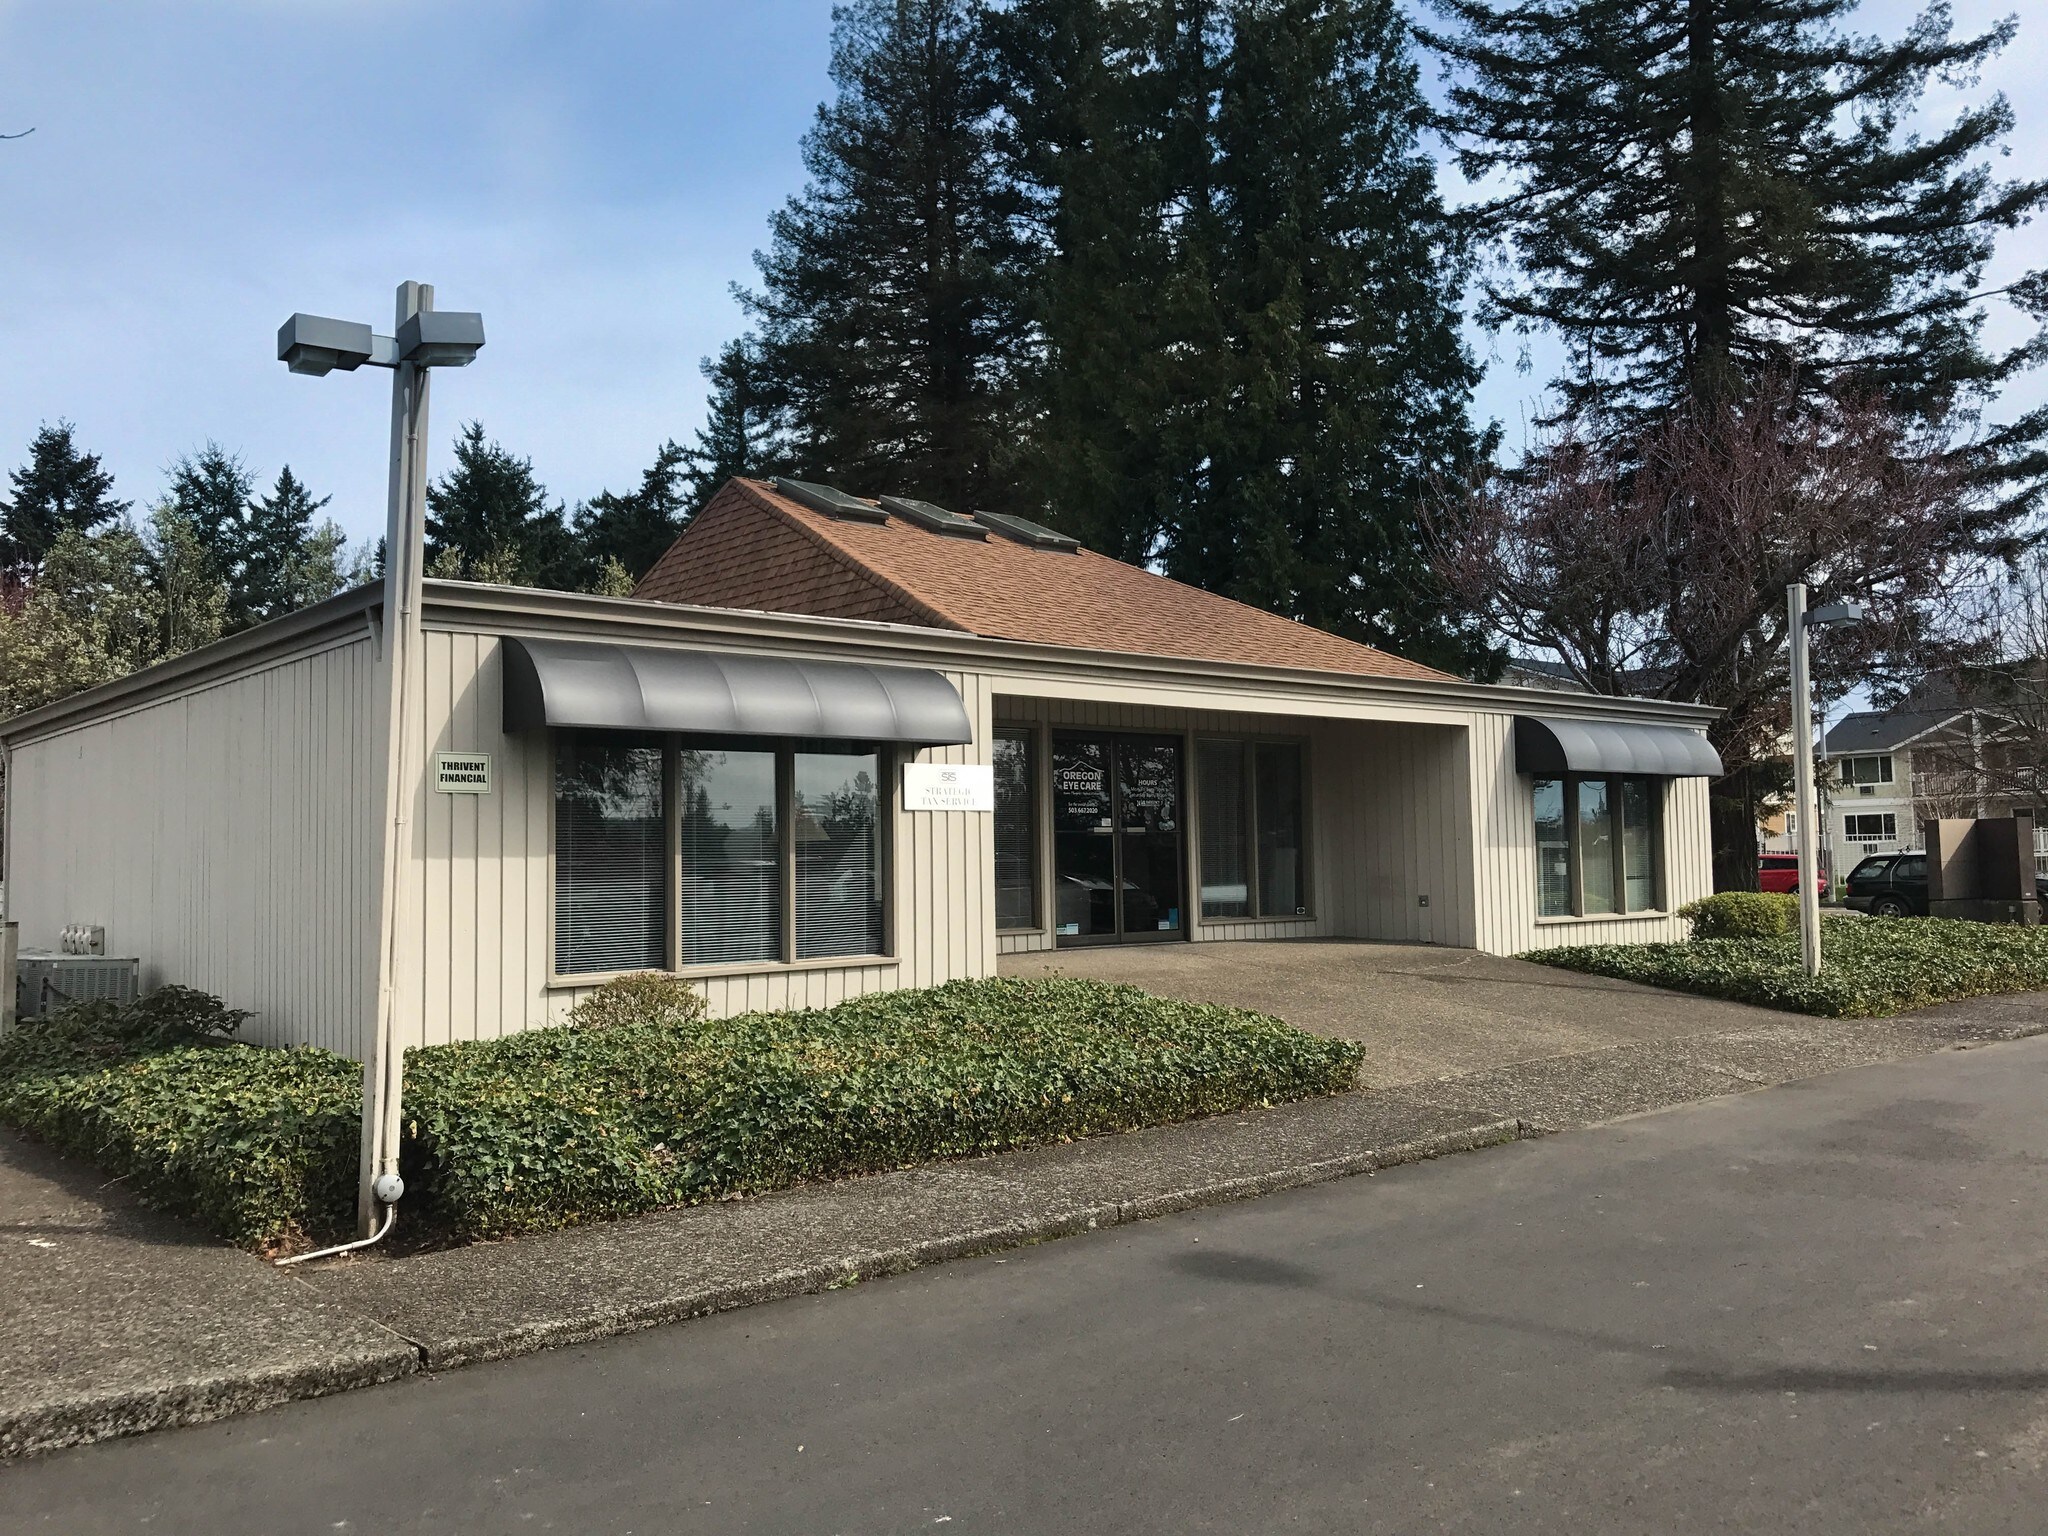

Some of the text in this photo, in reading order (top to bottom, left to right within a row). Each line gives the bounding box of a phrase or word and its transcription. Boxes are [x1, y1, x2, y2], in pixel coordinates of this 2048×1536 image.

[441, 761, 486, 771] THRIVENT
[440, 773, 487, 783] FINANCIAL
[1063, 771, 1101, 780] OREGON
[1063, 781, 1102, 790] EYE CARE
[925, 787, 972, 796] STRATEGIC
